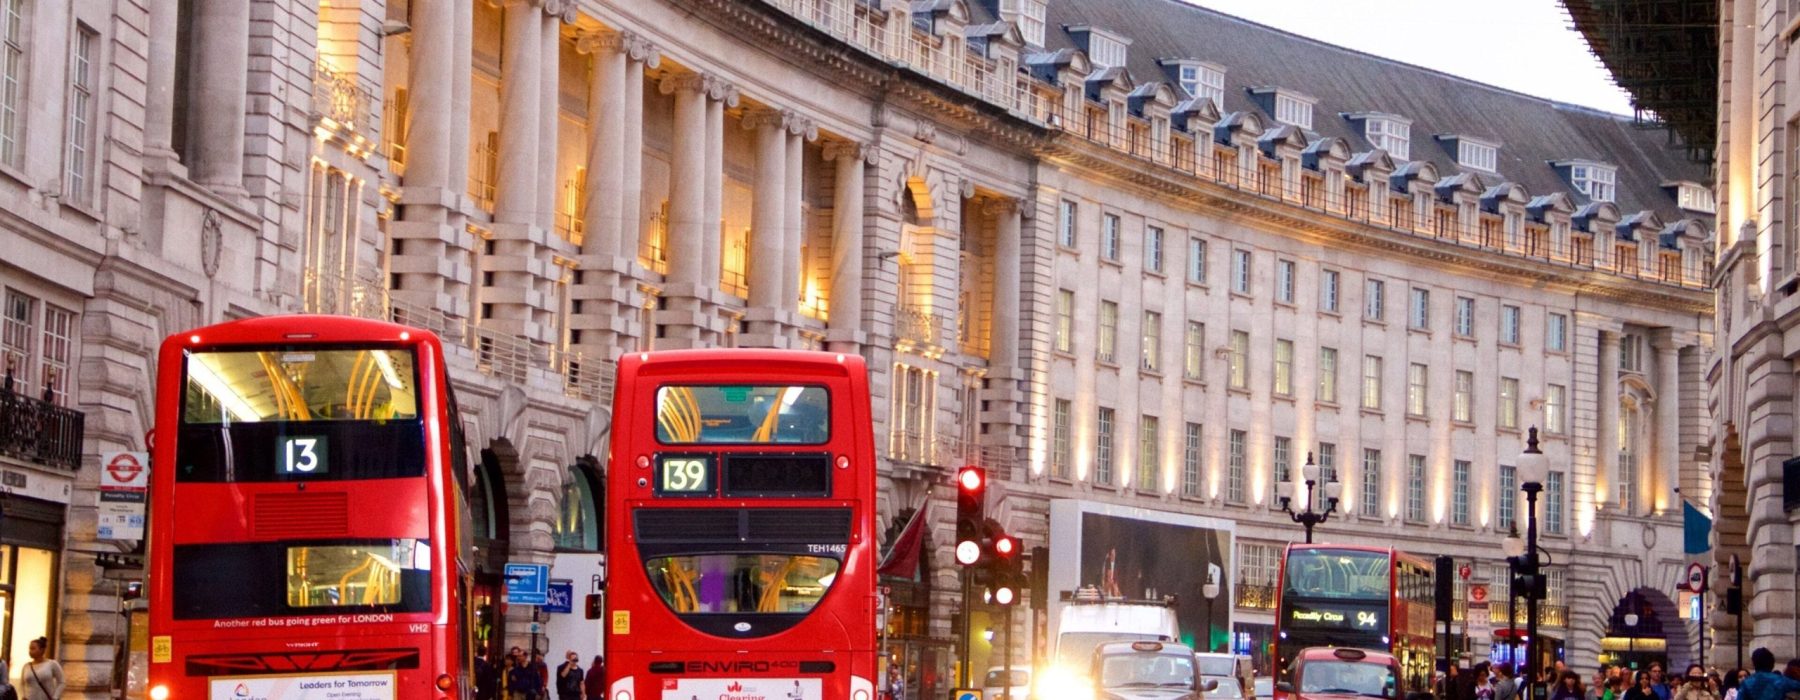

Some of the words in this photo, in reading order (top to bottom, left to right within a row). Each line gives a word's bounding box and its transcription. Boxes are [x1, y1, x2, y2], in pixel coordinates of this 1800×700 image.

[286, 438, 318, 472] 13
[664, 460, 705, 490] 139
[807, 543, 846, 553] TEH1465
[214, 620, 249, 628] Another
[252, 618, 267, 627] red
[268, 618, 284, 626] bus
[286, 617, 310, 627] going
[311, 617, 336, 626] green
[338, 615, 351, 624] for
[353, 614, 393, 623] LONDON
[1357, 611, 1376, 627] 94
[409, 624, 429, 633] VH2
[300, 681, 332, 690] Leaders
[333, 680, 346, 688] for
[347, 679, 388, 688] Tomorrow
